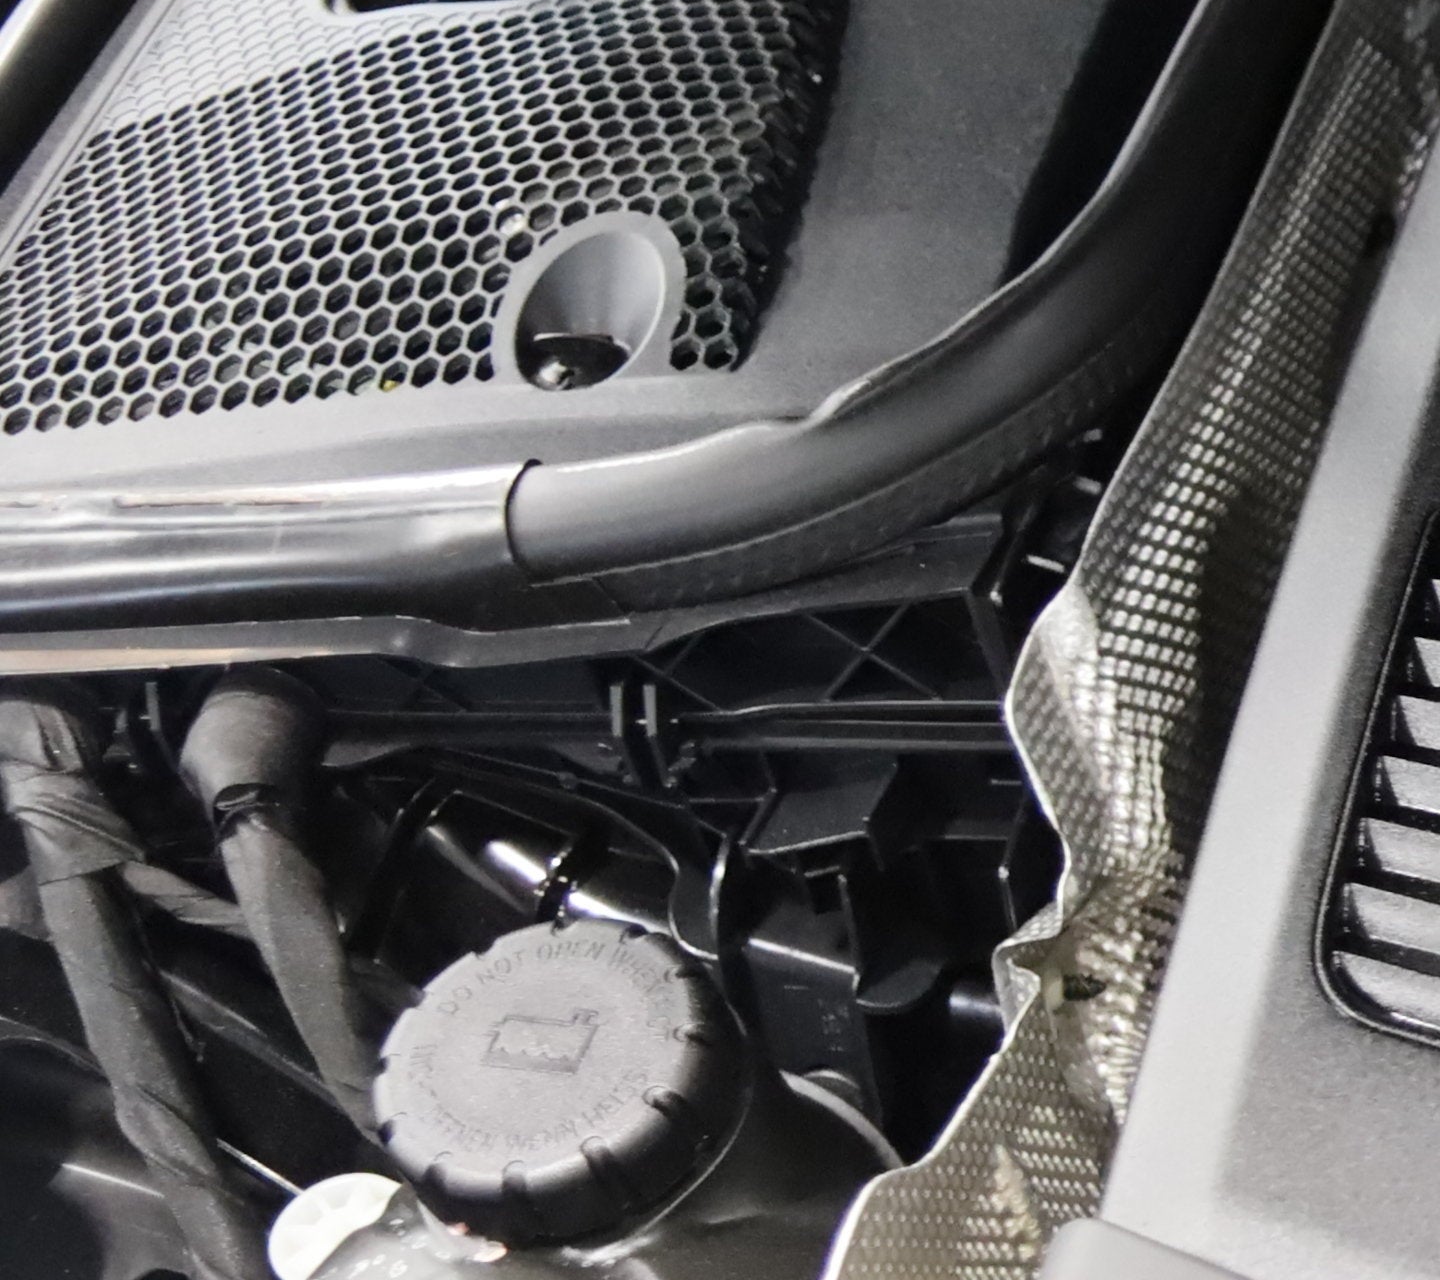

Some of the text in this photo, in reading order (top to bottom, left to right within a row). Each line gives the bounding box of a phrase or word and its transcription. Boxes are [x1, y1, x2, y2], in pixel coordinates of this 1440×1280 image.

[436, 987, 473, 1016] DO
[476, 950, 526, 985] NOT
[536, 939, 606, 963] OPEN
